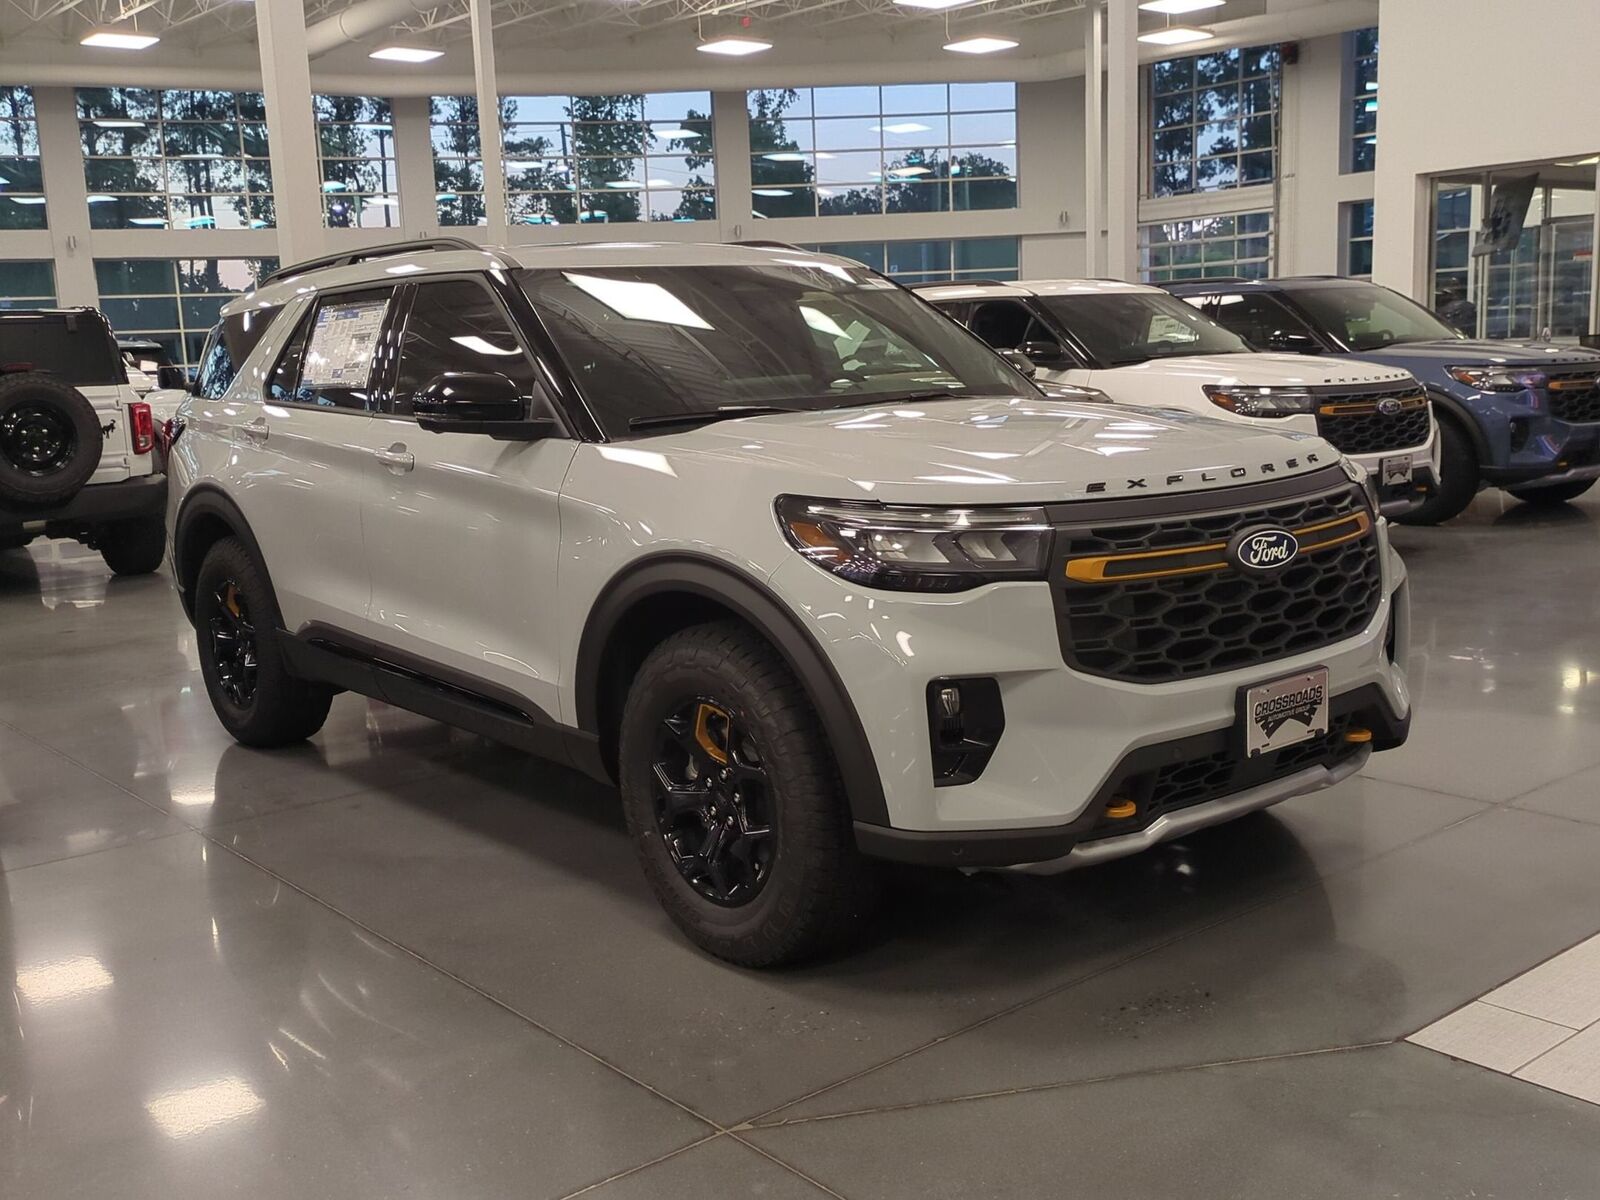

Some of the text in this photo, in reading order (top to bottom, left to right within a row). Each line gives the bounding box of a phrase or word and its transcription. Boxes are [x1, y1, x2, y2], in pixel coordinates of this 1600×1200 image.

[1086, 453, 1319, 493] EXPLORER
[1250, 536, 1288, 564] Ford
[1254, 685, 1323, 717] CROSSROADS
